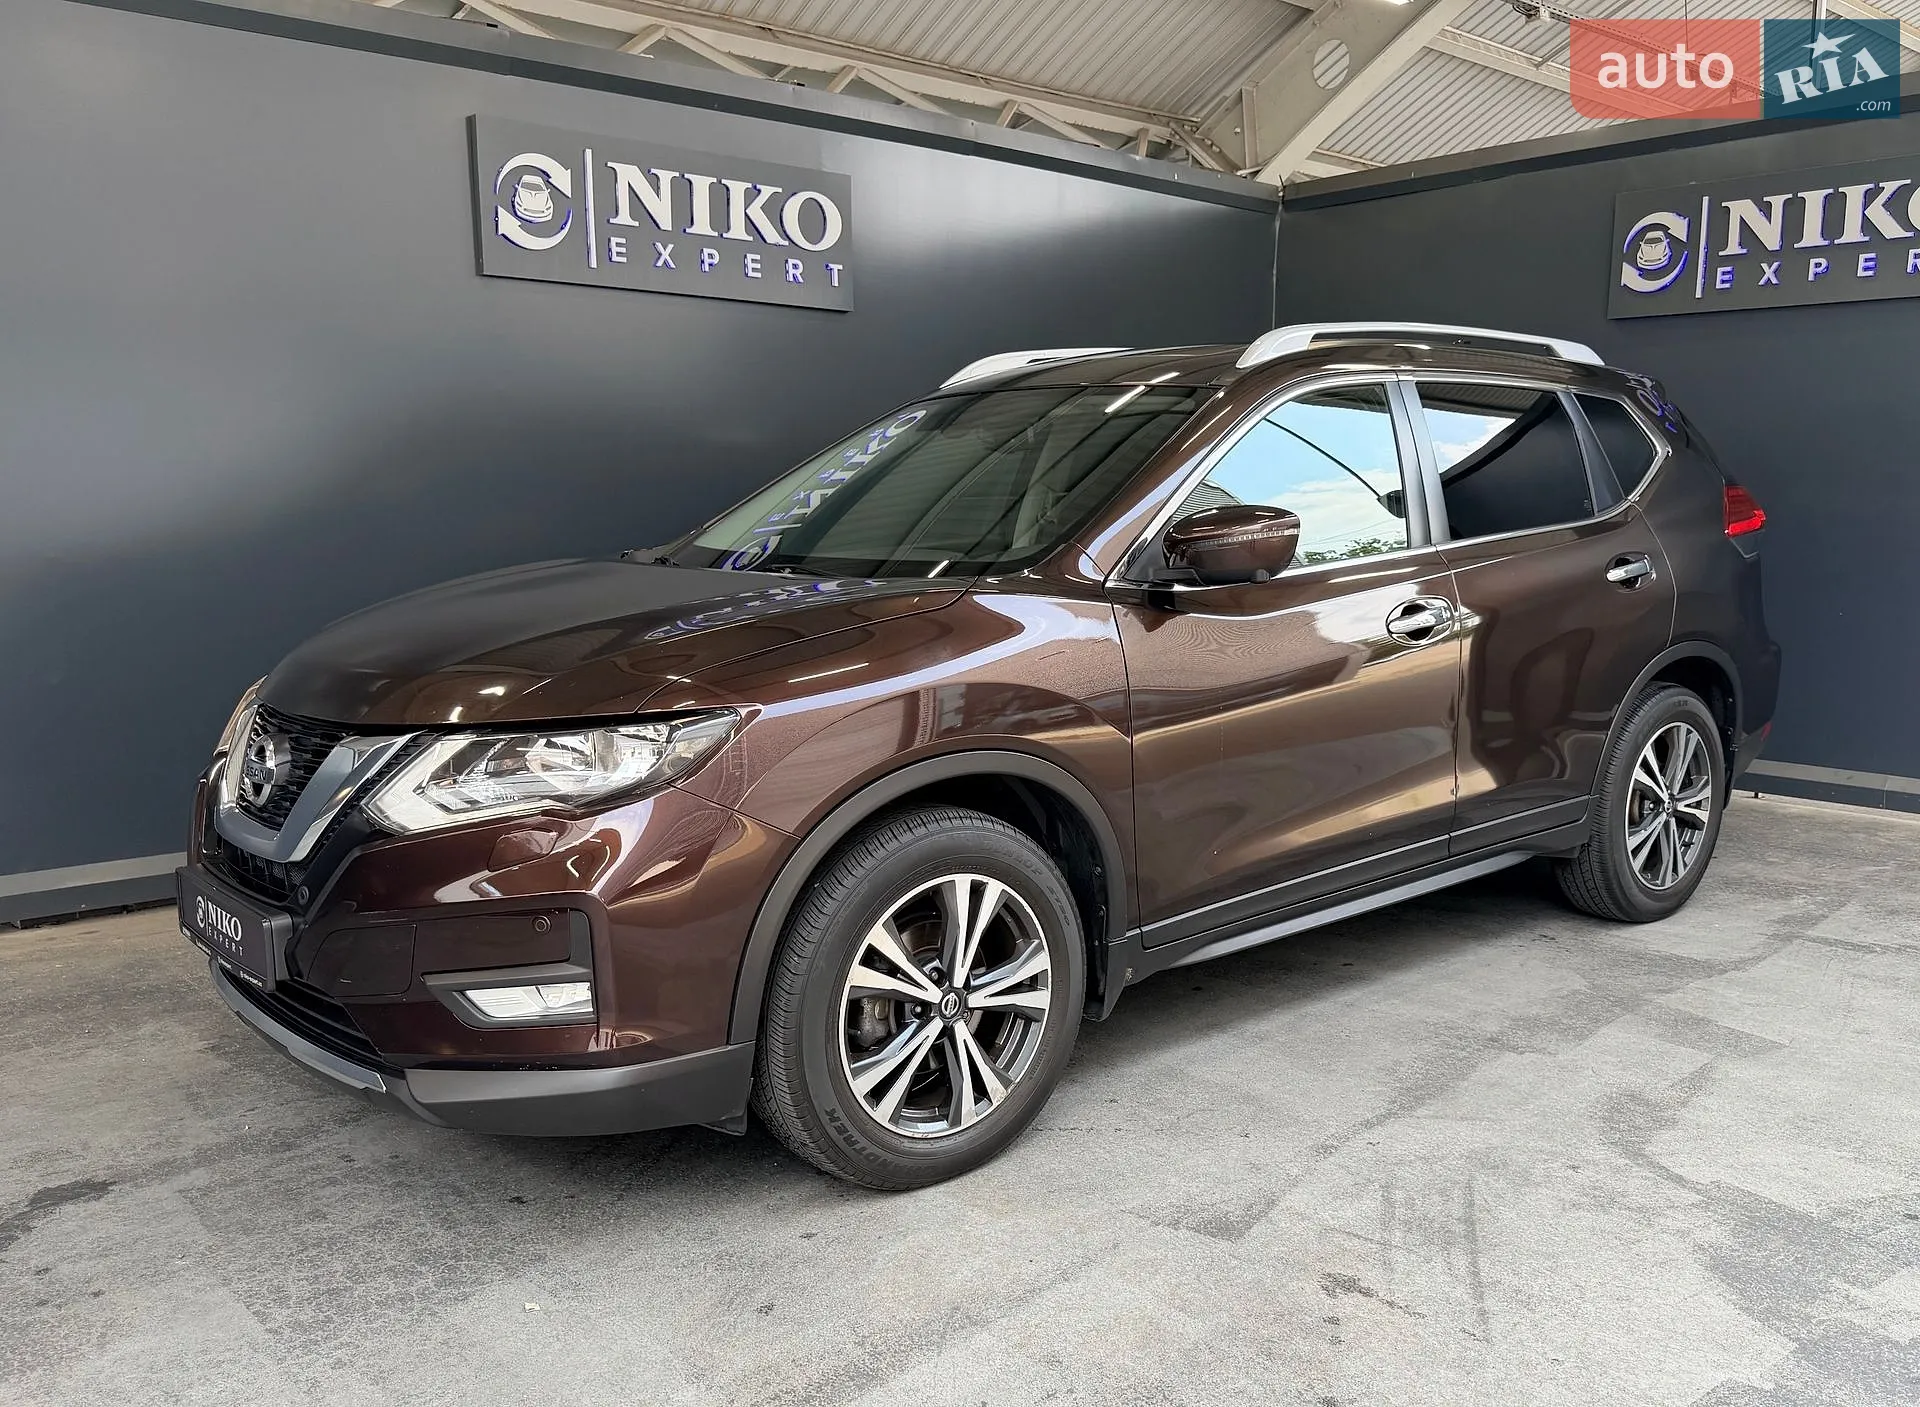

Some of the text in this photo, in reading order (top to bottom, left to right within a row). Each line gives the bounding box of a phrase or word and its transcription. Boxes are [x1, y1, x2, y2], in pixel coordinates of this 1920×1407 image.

[605, 161, 843, 252] NIKO
[1718, 179, 1920, 257] NIK
[608, 236, 843, 287] EXPERT
[208, 900, 242, 941] NIKO
[209, 926, 243, 956] EXPERT
